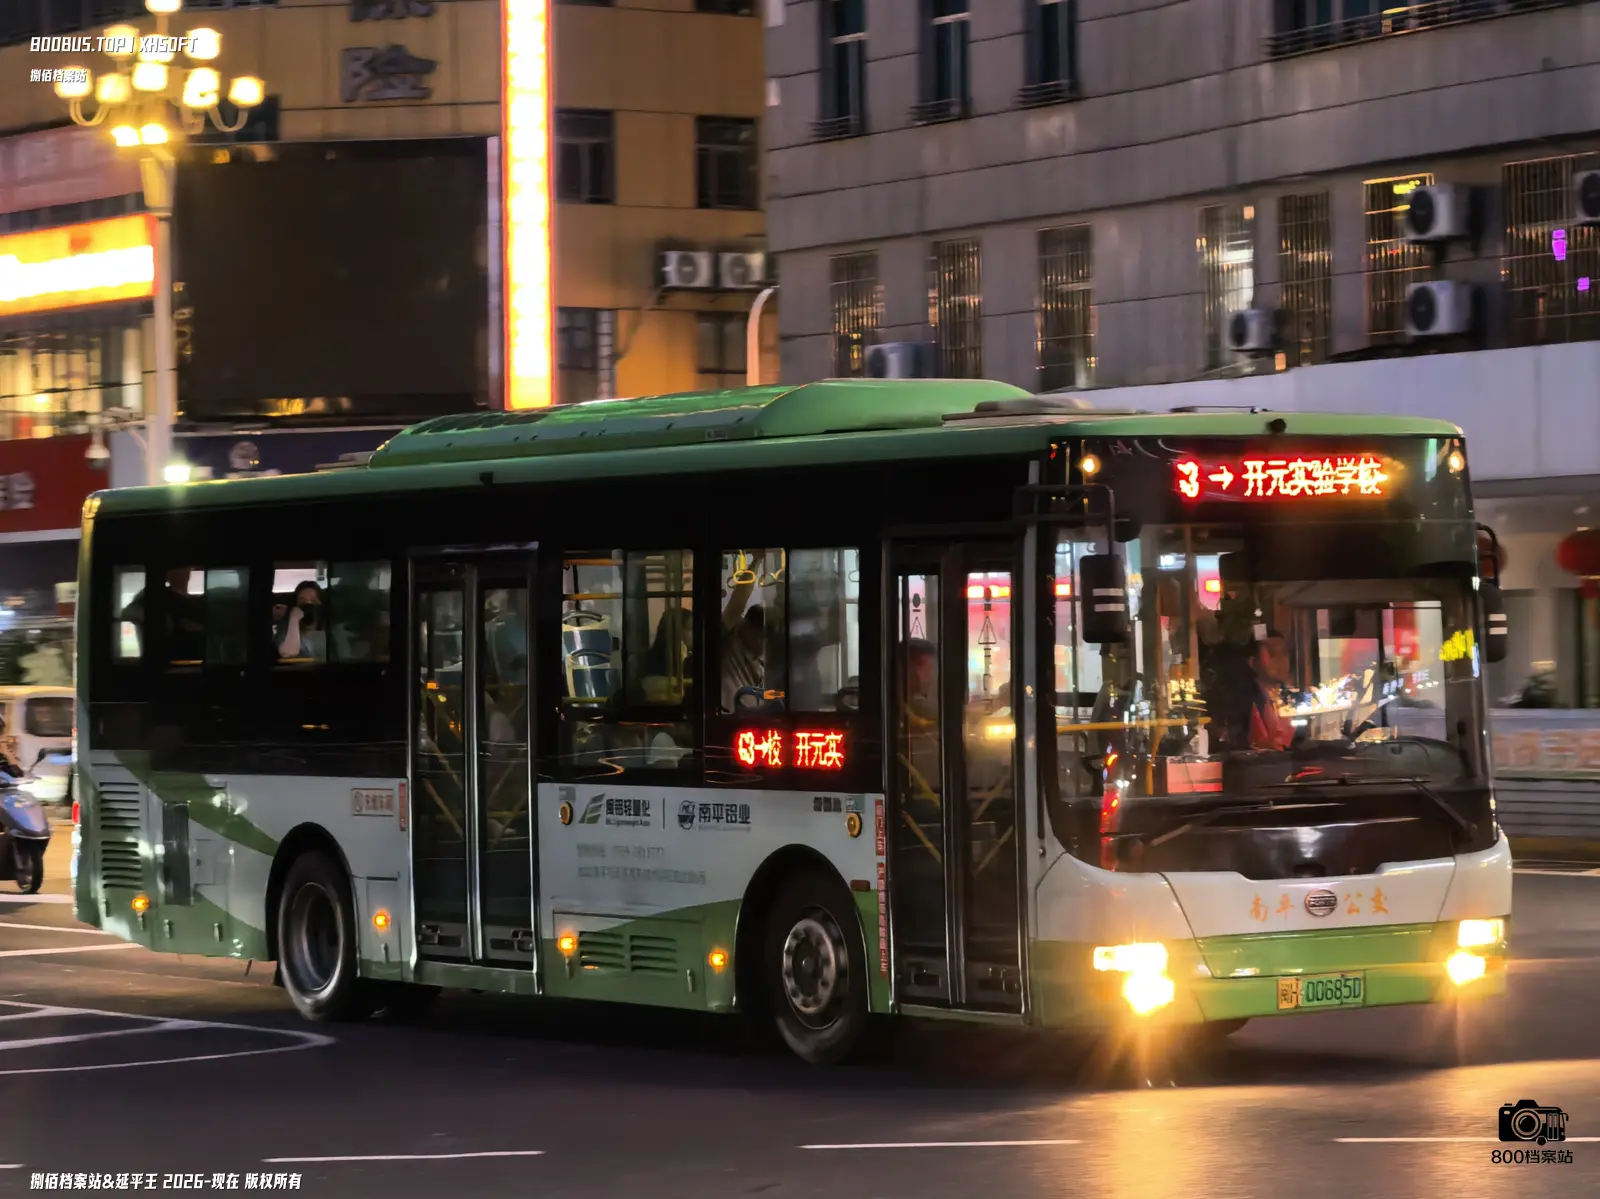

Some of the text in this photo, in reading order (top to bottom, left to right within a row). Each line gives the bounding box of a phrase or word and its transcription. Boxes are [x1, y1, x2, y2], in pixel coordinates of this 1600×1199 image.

[1176, 456, 1388, 498] 3 开元实验学校
[795, 731, 845, 768] 开元实
[698, 803, 752, 825] 南平铝业
